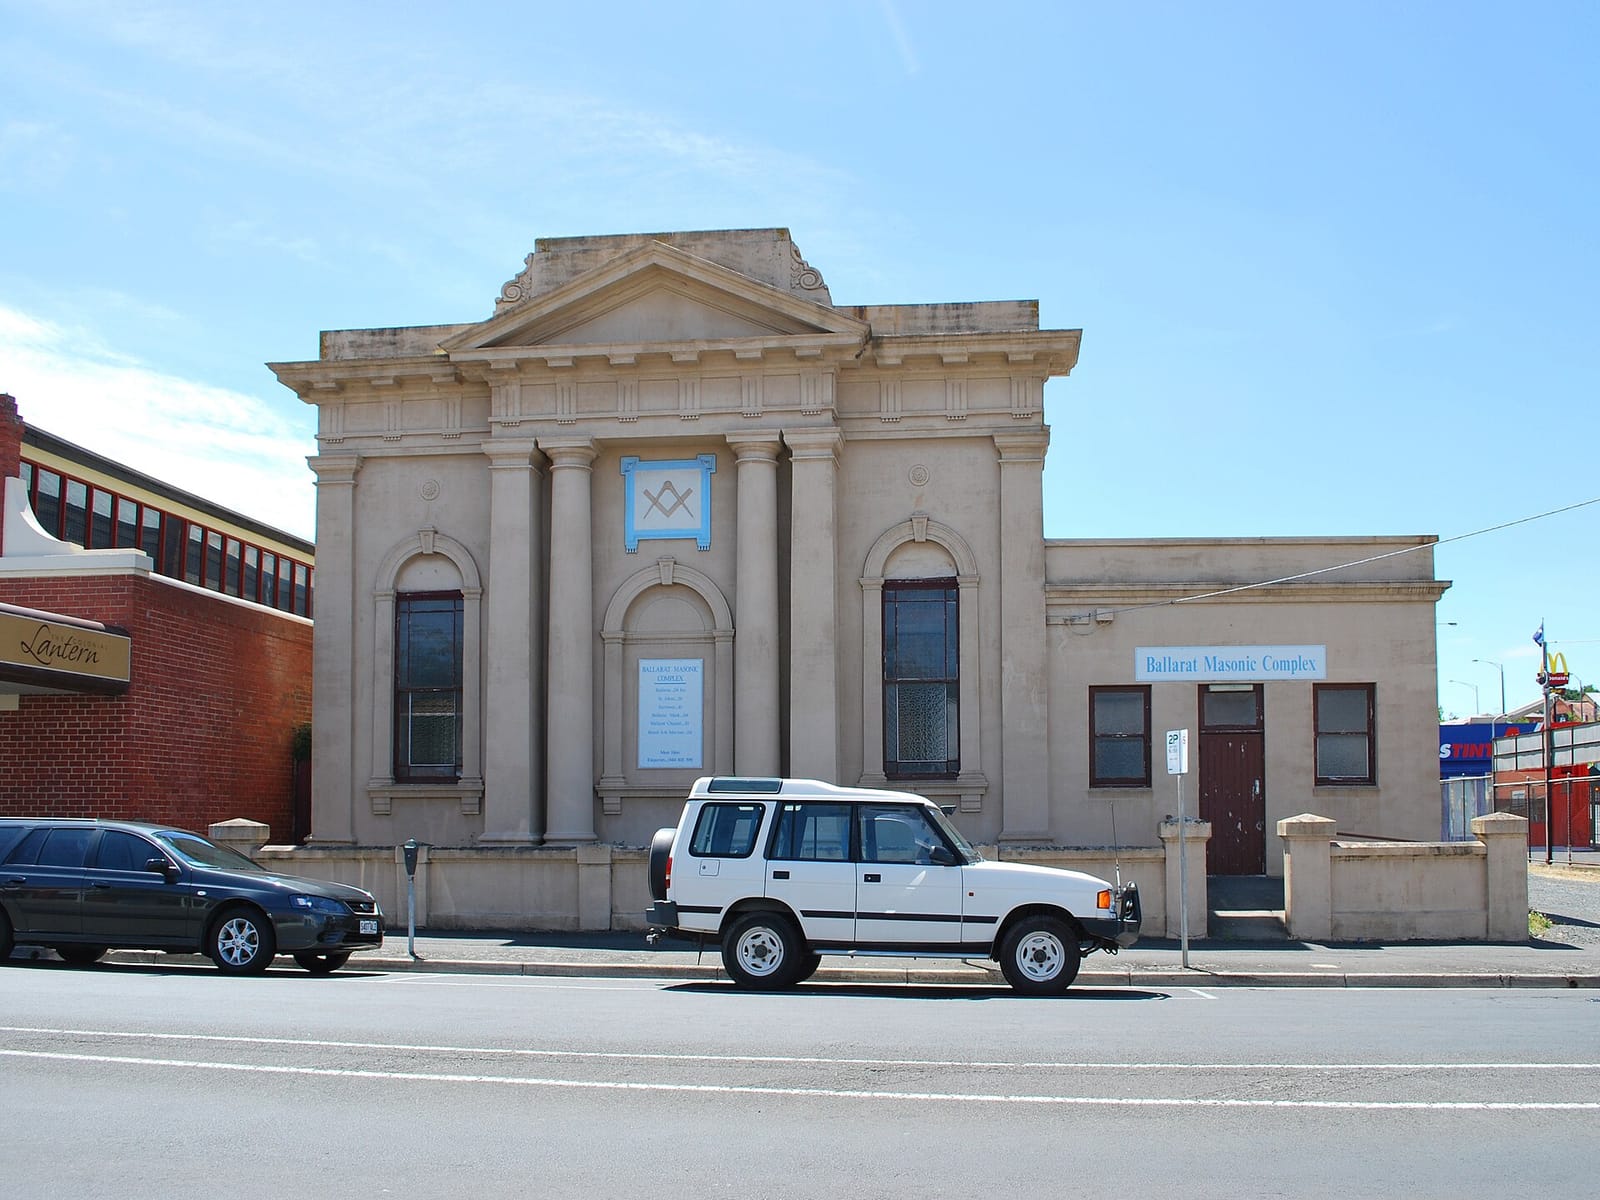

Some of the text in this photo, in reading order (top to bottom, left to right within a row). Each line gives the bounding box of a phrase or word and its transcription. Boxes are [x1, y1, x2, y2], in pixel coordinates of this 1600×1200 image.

[20, 624, 100, 666] Lantern
[1146, 655, 1317, 675] Ballarat Masonic Complex
[1168, 734, 1179, 745] 2P
